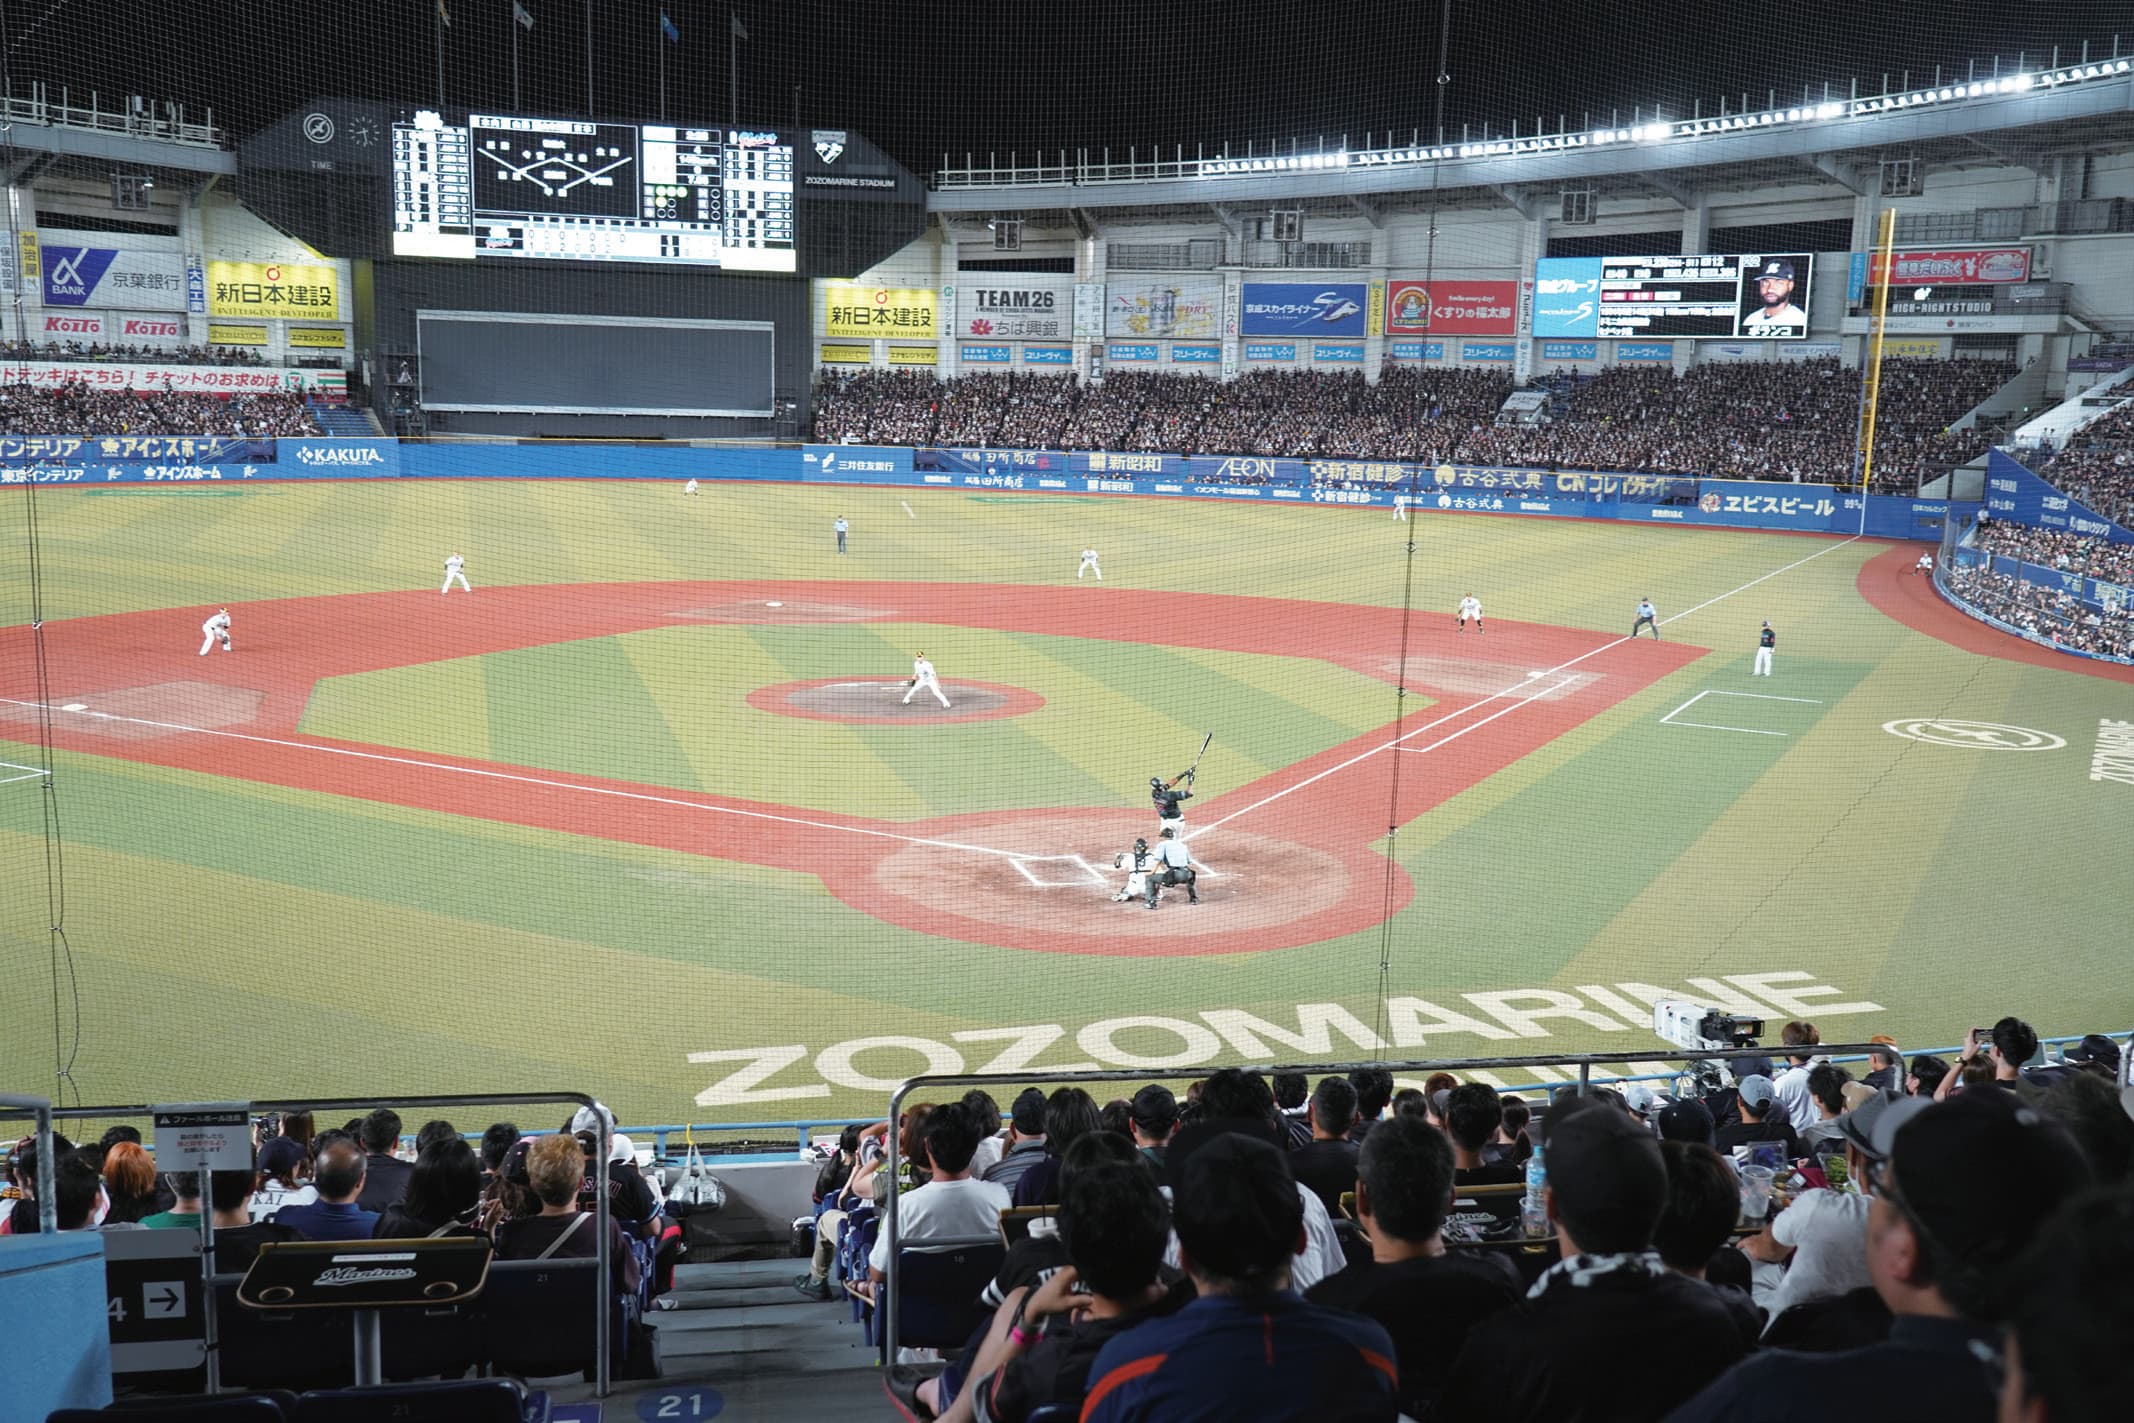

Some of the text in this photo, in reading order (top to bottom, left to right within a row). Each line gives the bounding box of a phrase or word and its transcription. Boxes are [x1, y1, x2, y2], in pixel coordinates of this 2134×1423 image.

[311, 161, 333, 170] TIME
[805, 176, 895, 187] ZOZOMARINE STADIUM
[112, 272, 181, 291] 京葉銀行
[52, 285, 86, 296] BANK
[216, 282, 332, 307] 新日本建設
[832, 306, 931, 327] 新日本建設
[1245, 303, 1320, 314] 京成スカイライナー
[1434, 306, 1511, 319] くすりの福太郎
[995, 320, 1058, 337] ちば興銀
[145, 371, 280, 387] チケットのお求めは
[314, 448, 379, 462] KAKUTA
[838, 460, 895, 472] 三井住友銀行
[1108, 455, 1162, 472] 新昭和
[1, 467, 84, 483] 東京インテリア
[156, 465, 222, 480] アインスホーム
[1459, 470, 1544, 490] 古谷式典
[1100, 481, 1134, 492] 新昭和
[1453, 498, 1505, 510] 古谷式典
[1723, 495, 1836, 517] ヱビスビール
[687, 971, 1886, 1106] ZOZOMARINE
[313, 1267, 417, 1286] Marines
[656, 1394, 703, 1418] 21
